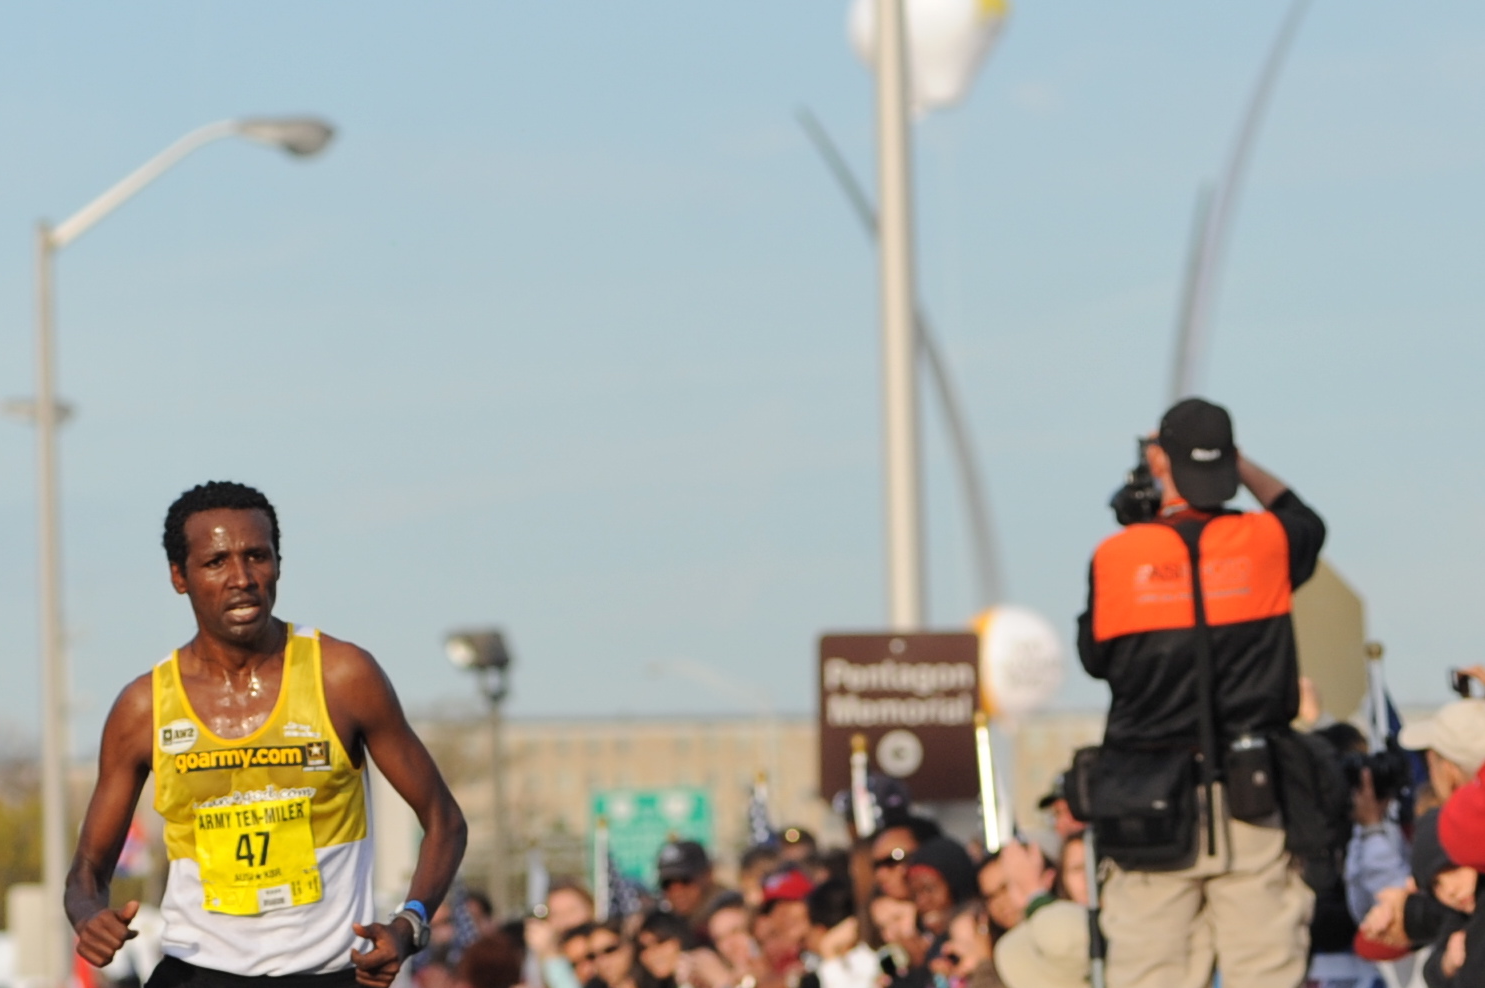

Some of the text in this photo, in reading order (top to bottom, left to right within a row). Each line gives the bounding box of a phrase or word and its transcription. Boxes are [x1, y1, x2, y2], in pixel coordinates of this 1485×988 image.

[823, 657, 976, 697] Pentagon
[826, 692, 974, 727] Memorial
[175, 746, 302, 774] goarmy.com
[198, 801, 305, 831] ARMY TEN-MILER
[235, 831, 271, 868] 47
